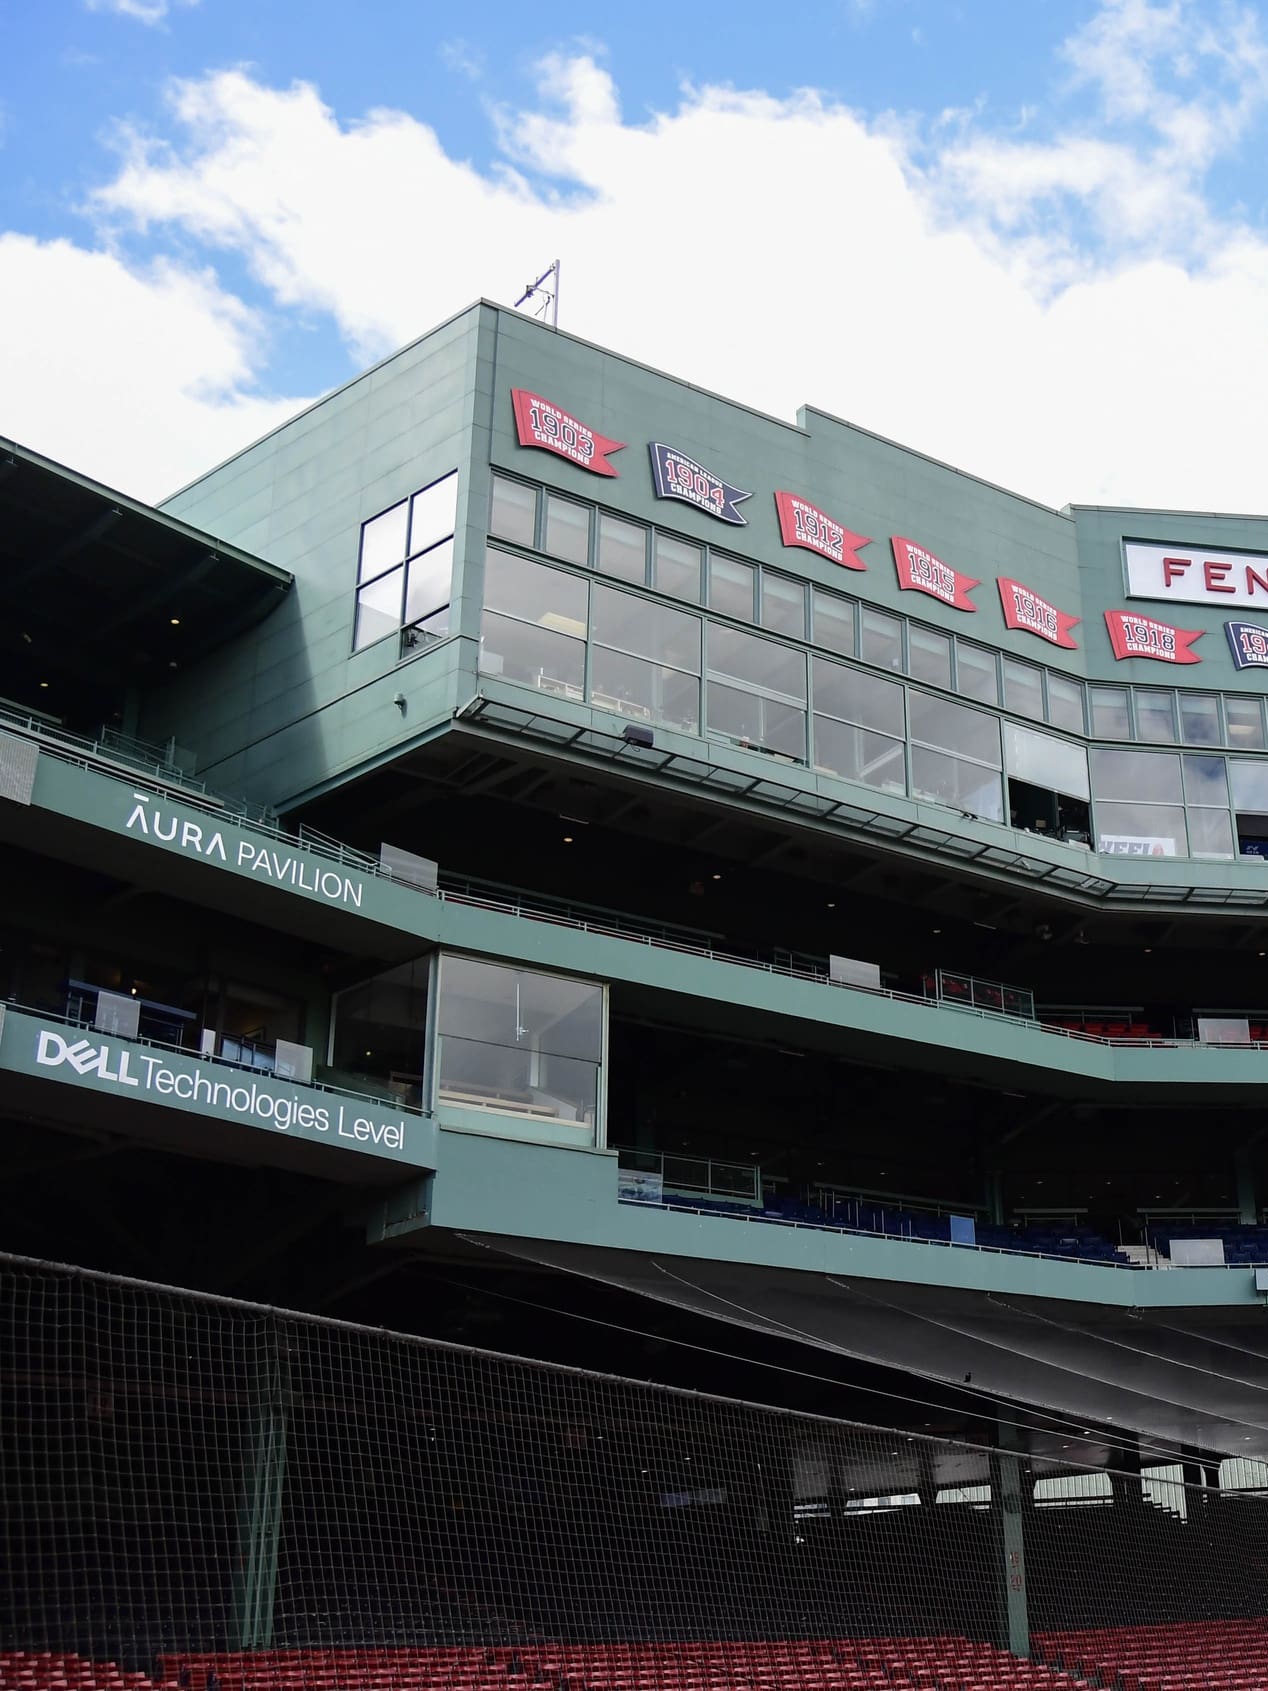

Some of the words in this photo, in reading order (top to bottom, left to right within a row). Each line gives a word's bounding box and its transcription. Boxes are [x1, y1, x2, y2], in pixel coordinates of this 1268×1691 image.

[530, 408, 594, 458] 1903
[531, 399, 561, 419] WORLD
[563, 415, 592, 438] SERIES
[535, 431, 590, 465] CHAMPIONS
[667, 453, 698, 472] AMERICAN
[666, 460, 725, 509] 1904
[670, 482, 722, 515] CHAMPIONS
[792, 500, 817, 517] WORLD
[819, 514, 843, 534] SERIES
[794, 509, 844, 551] 1912
[796, 531, 842, 560] CHAMPIONS
[906, 544, 930, 562] WORLD
[932, 558, 954, 578] SERIES
[909, 553, 954, 594] 1915
[911, 574, 954, 602] CHAMPIONS
[1011, 585, 1034, 601] WORLD
[1036, 597, 1057, 615] SERIES
[1013, 594, 1057, 633] 1916
[1017, 614, 1057, 640] CHAMPIONS
[1120, 615, 1147, 627] WORLD
[1149, 620, 1175, 635] SERIES
[1123, 623, 1175, 651] 1918
[1240, 627, 1268, 638] AMERICAN
[1127, 642, 1175, 659] CHAMPIONS
[237, 841, 363, 907] PAVILION
[36, 1030, 139, 1087] DELL
[140, 1055, 330, 1130] Technologies
[338, 1106, 405, 1150] Level
